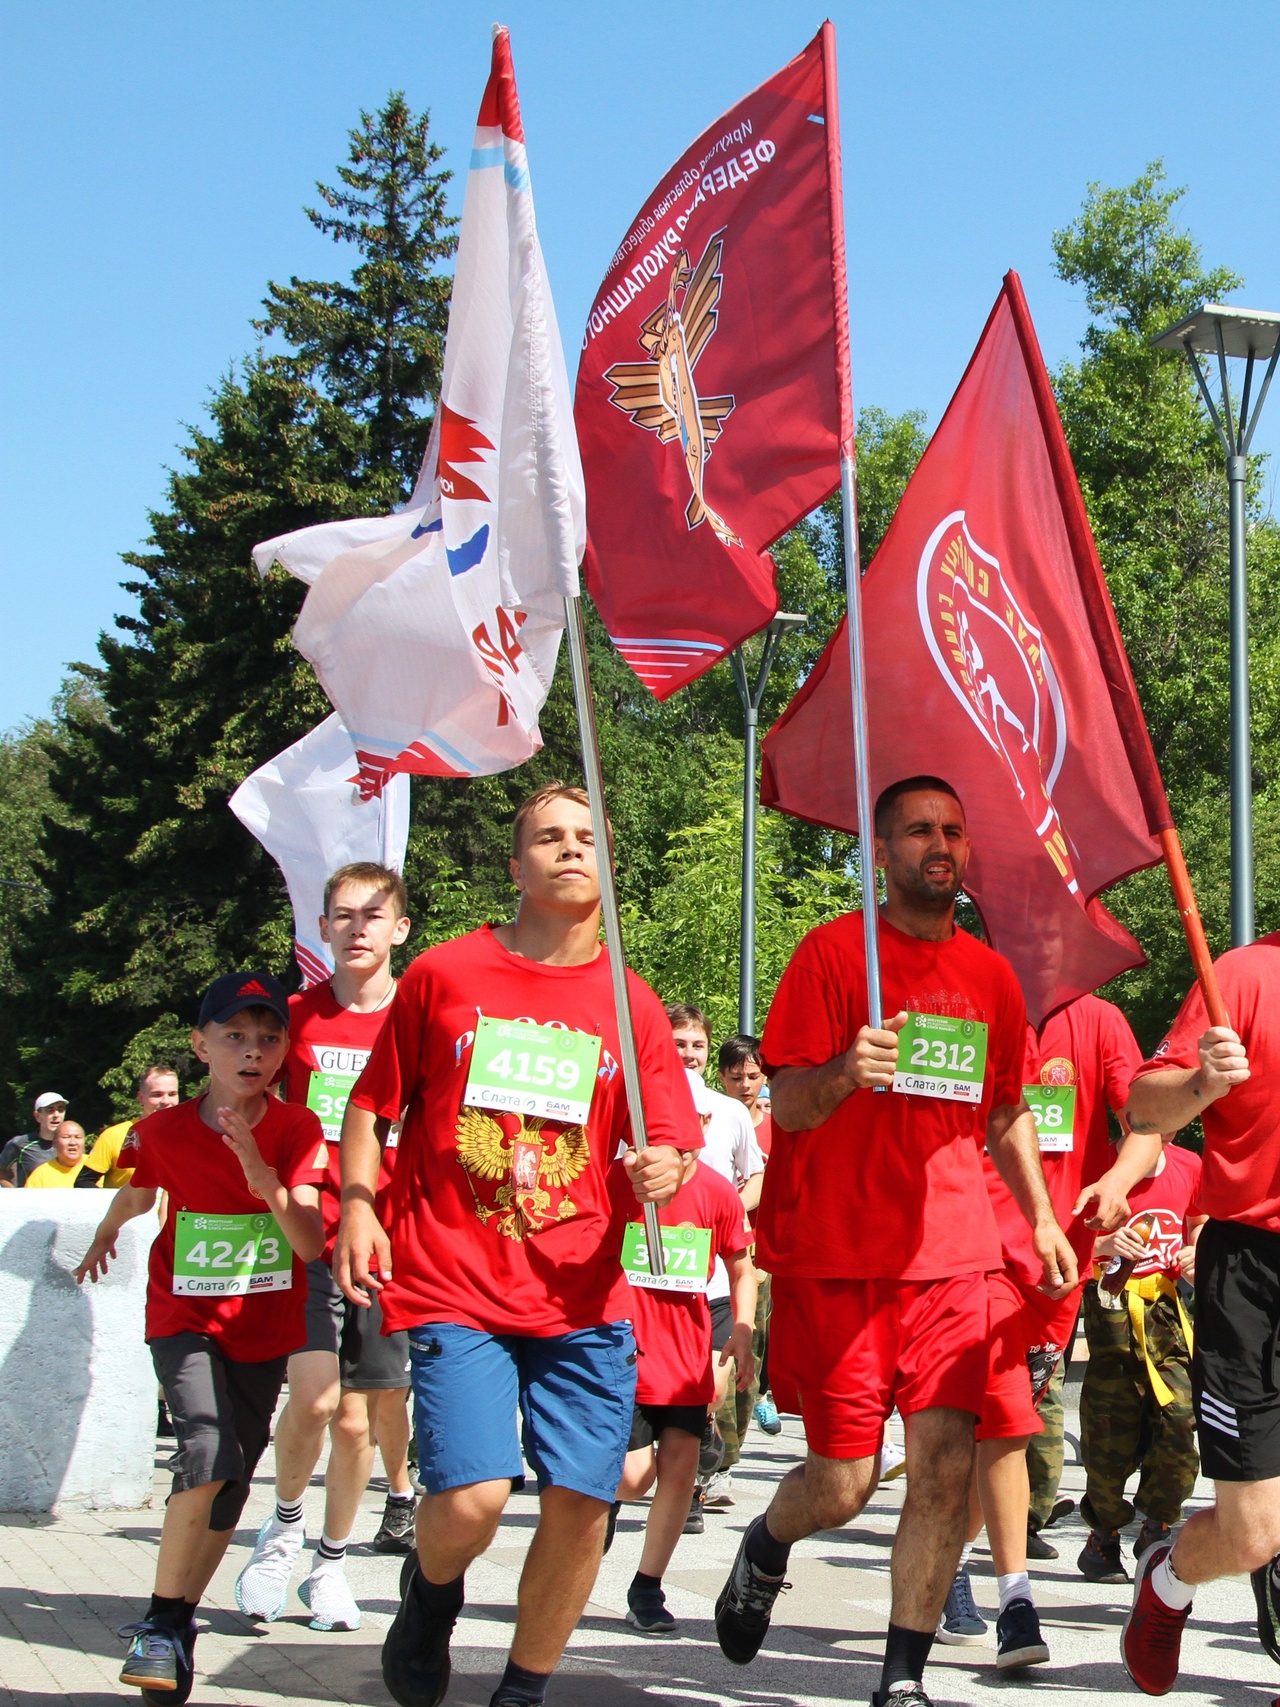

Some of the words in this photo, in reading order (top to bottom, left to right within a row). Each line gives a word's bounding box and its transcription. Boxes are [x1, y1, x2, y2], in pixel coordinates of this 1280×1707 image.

[910, 1038, 976, 1074] 2312
[486, 1050, 581, 1090] 4159
[905, 1076, 936, 1091] Слата
[953, 1083, 971, 1092] БАМ
[481, 1089, 521, 1106] Слата
[546, 1101, 571, 1111] БАМ
[185, 1237, 280, 1268] 4243
[187, 1279, 225, 1292] Слата
[250, 1275, 273, 1285] БАМ
[628, 1272, 657, 1285] Слата
